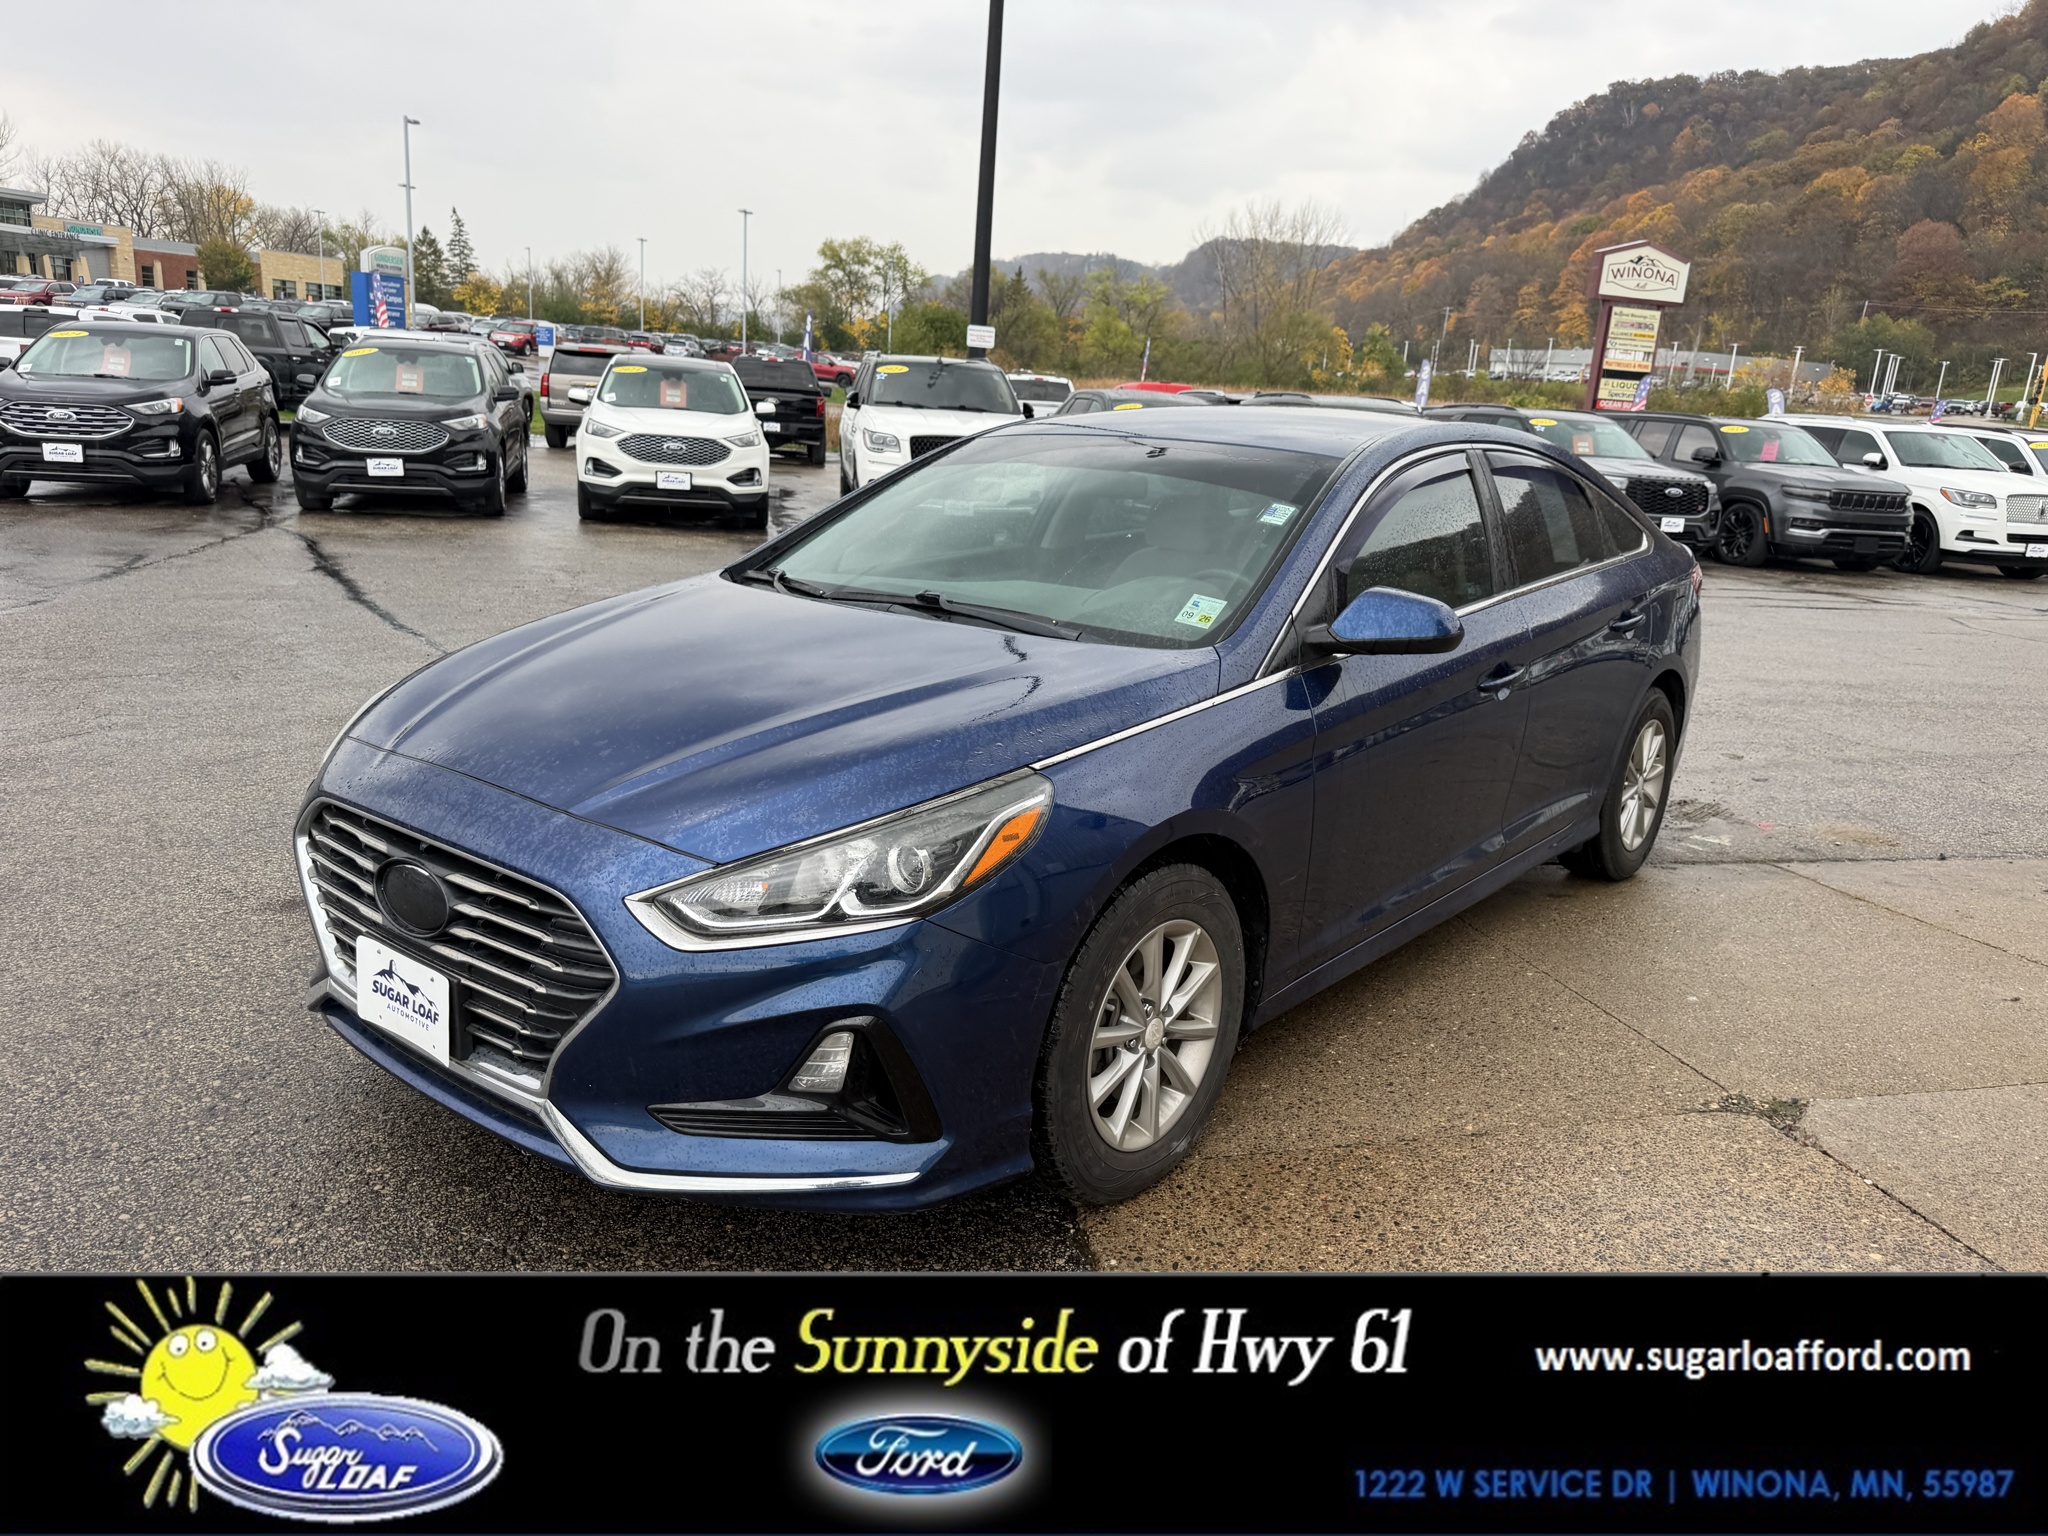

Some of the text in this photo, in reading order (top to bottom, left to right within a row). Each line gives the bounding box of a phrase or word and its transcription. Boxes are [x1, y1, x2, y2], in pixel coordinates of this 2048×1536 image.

[31, 228, 80, 240] CLINIC ENTRANCE
[1611, 266, 1675, 287] WINONA
[1600, 400, 1622, 409] OCEAN
[1181, 610, 1212, 624] 09 26
[372, 979, 440, 1026] SUGAR LOAF
[386, 1003, 430, 1032] AUTOMOTIVE
